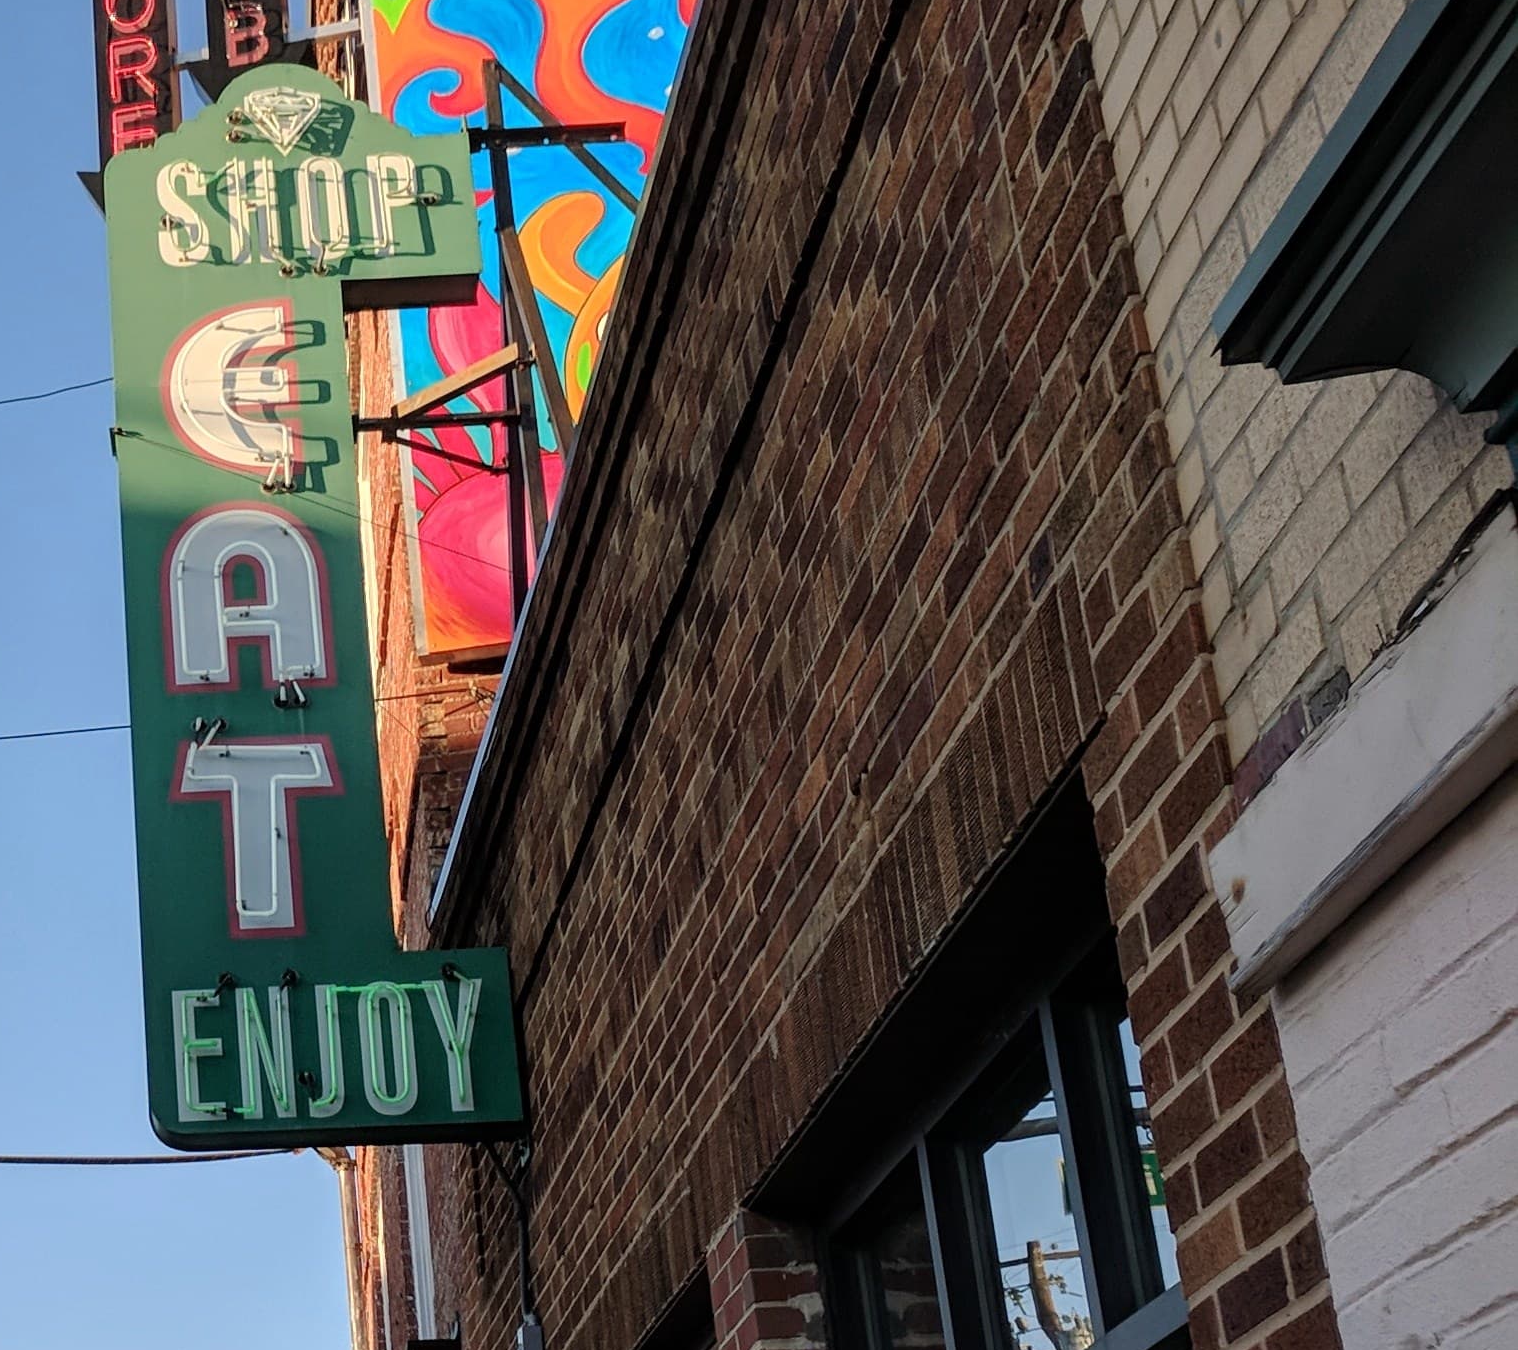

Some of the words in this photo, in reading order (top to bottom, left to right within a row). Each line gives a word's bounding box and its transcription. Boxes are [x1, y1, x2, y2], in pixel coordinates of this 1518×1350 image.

[155, 153, 420, 268] SHOP
[164, 302, 341, 937] EAT
[172, 977, 484, 1124] ENJOY
